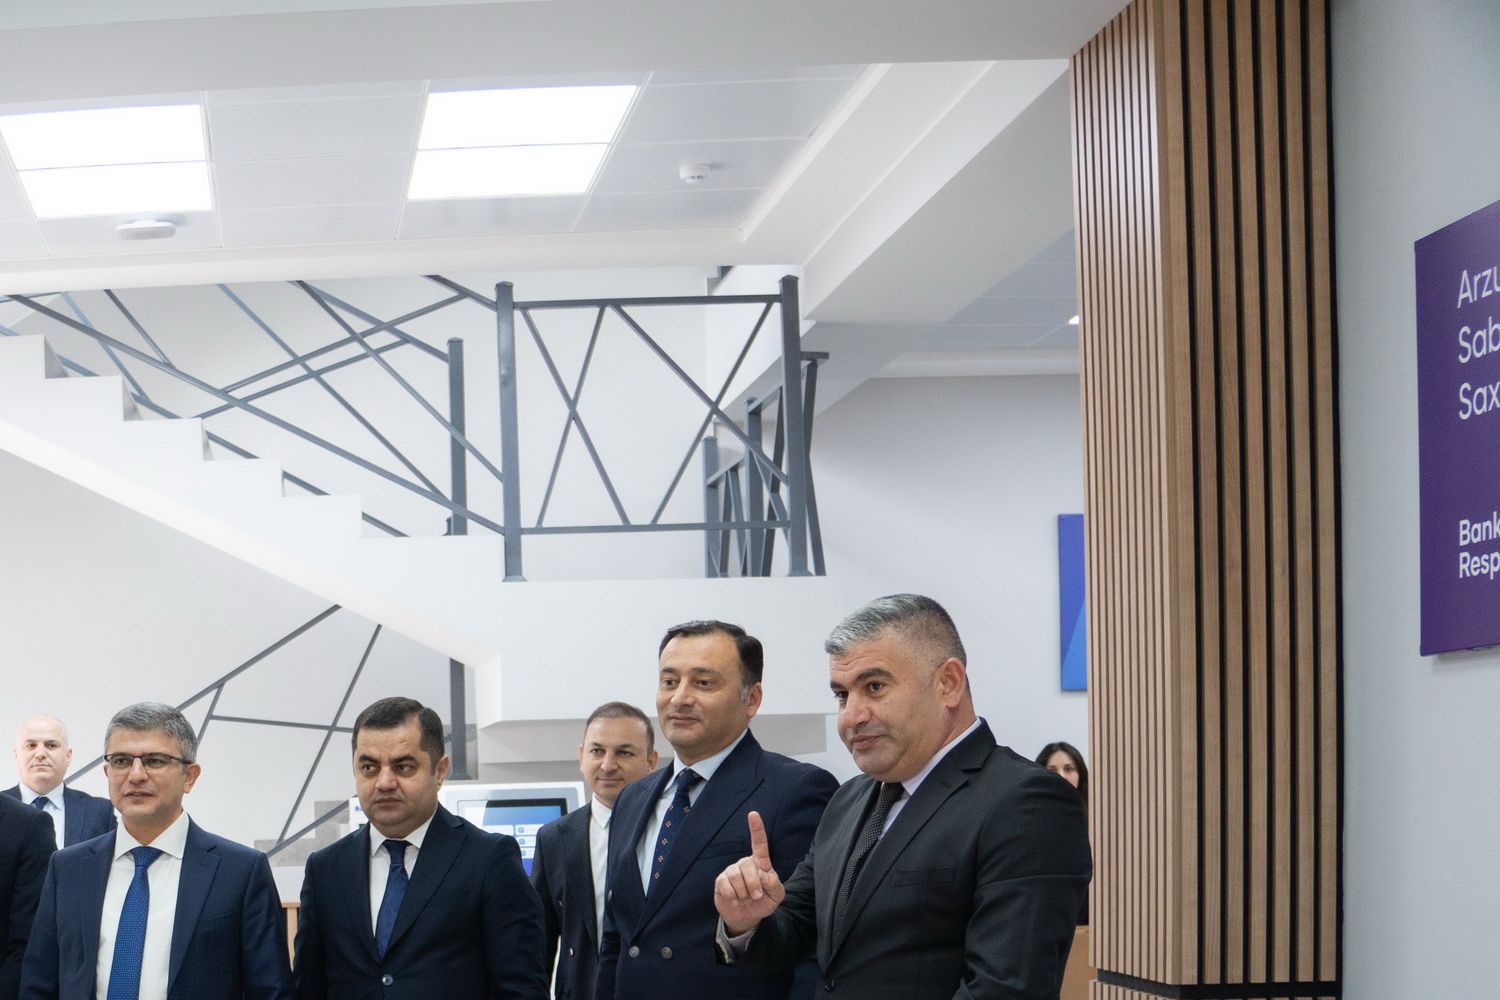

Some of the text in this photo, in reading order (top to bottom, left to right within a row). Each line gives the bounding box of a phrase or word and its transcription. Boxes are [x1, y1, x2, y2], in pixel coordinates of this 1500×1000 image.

[1458, 316, 1500, 364] Sab
[1459, 381, 1500, 420] Sax
[1459, 511, 1500, 546] Bank
[1459, 551, 1500, 580] Resp
